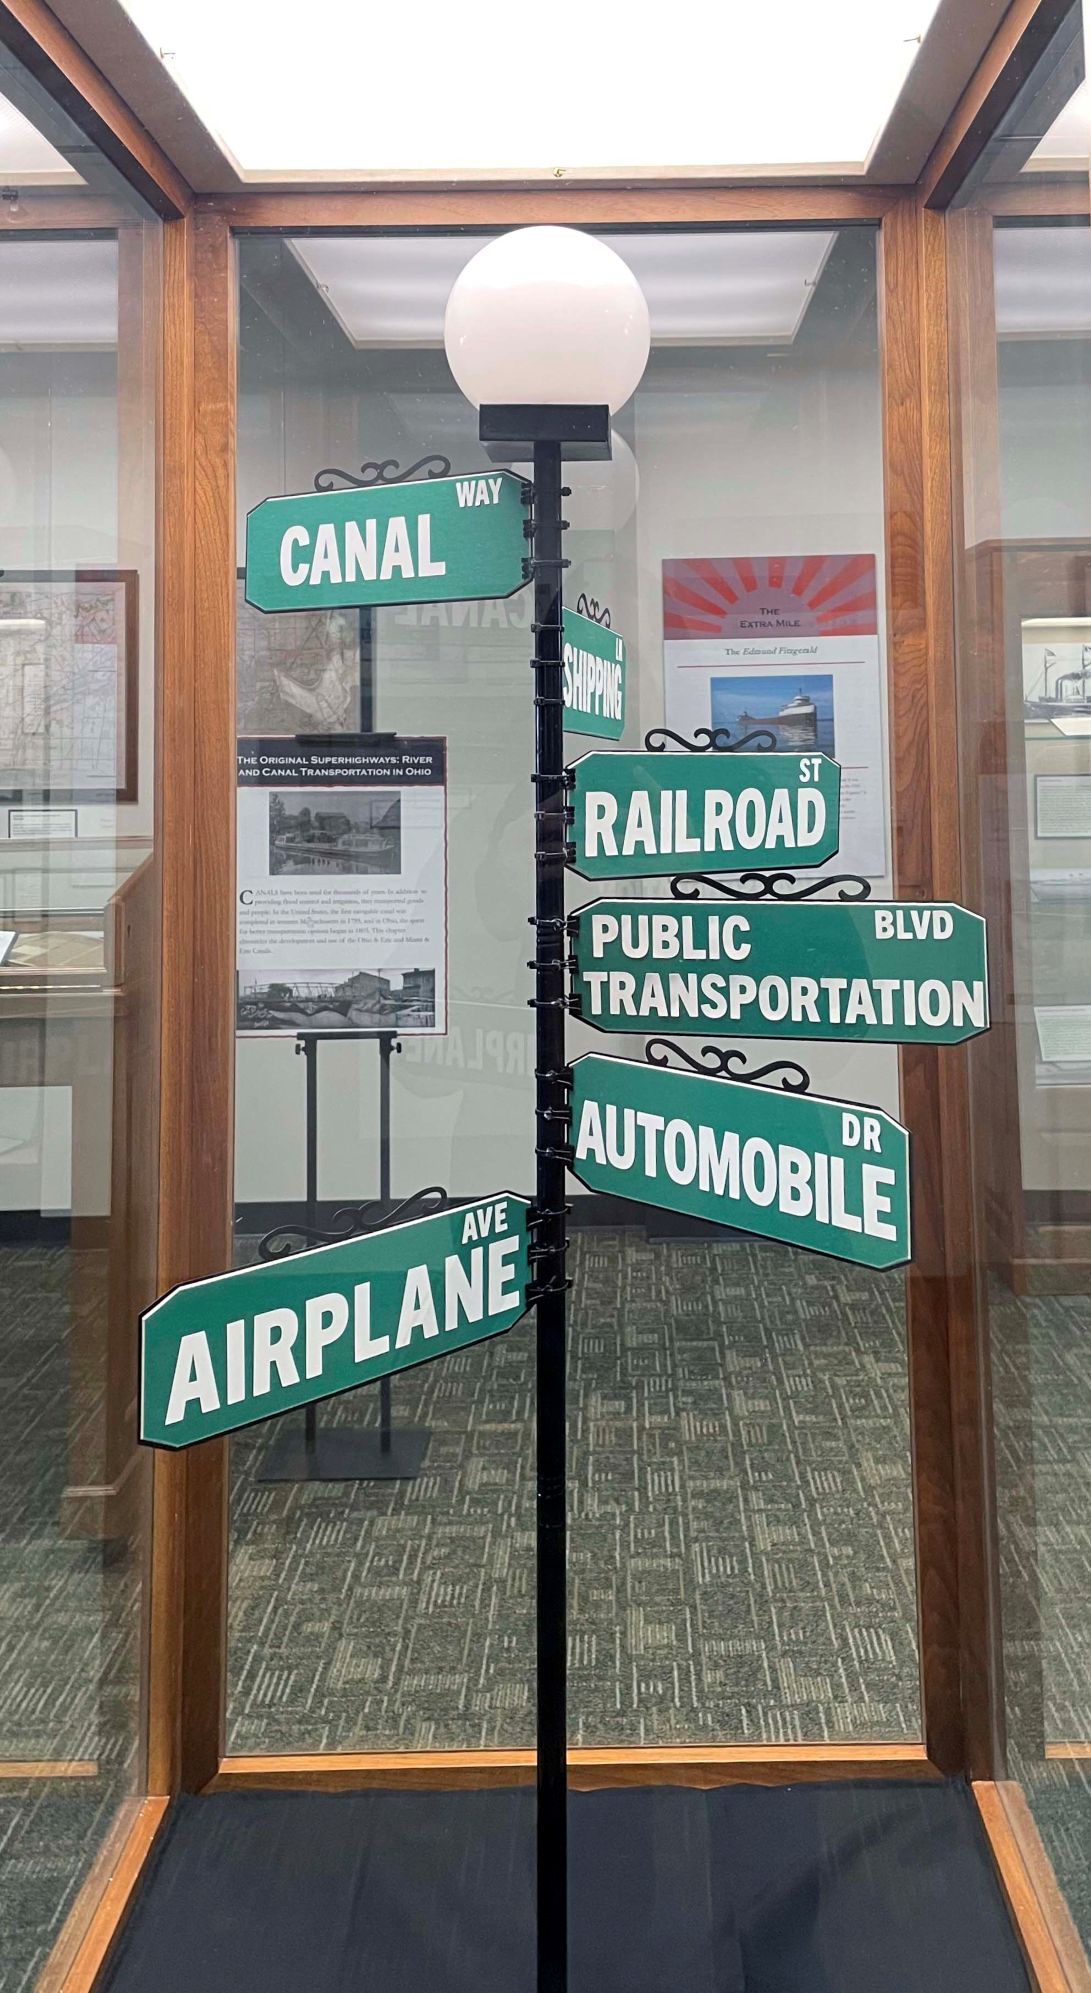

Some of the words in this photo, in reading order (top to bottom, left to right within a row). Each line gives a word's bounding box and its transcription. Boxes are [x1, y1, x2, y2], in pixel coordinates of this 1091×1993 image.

[456, 478, 502, 507] WAY
[280, 514, 446, 586] CANAL
[740, 620, 773, 628] EXTRA
[776, 619, 800, 628] MILE
[760, 607, 780, 616] THE
[725, 648, 740, 656] The
[563, 642, 622, 720] SHIPPING
[237, 755, 257, 764] THE
[260, 755, 309, 764] ORIGINAL
[311, 755, 400, 764] SUPERHIGHWAYS:
[402, 755, 433, 764] RIVER
[238, 768, 260, 776] AND
[262, 767, 298, 776] CANAL
[300, 767, 391, 776] TRANSPORTATION
[393, 768, 403, 776] IN
[405, 767, 432, 776] OHIO
[799, 758, 822, 783] ST
[585, 787, 826, 857] RAILROAD
[591, 914, 752, 961] PUBLIC
[874, 910, 954, 940] BLVD
[582, 971, 984, 1028] TRANSPORTATION
[842, 1112, 882, 1153] DR
[575, 1099, 897, 1241] AUTOMOBILE
[462, 1201, 509, 1244] AVE
[164, 1235, 520, 1426] AIRPLANE
